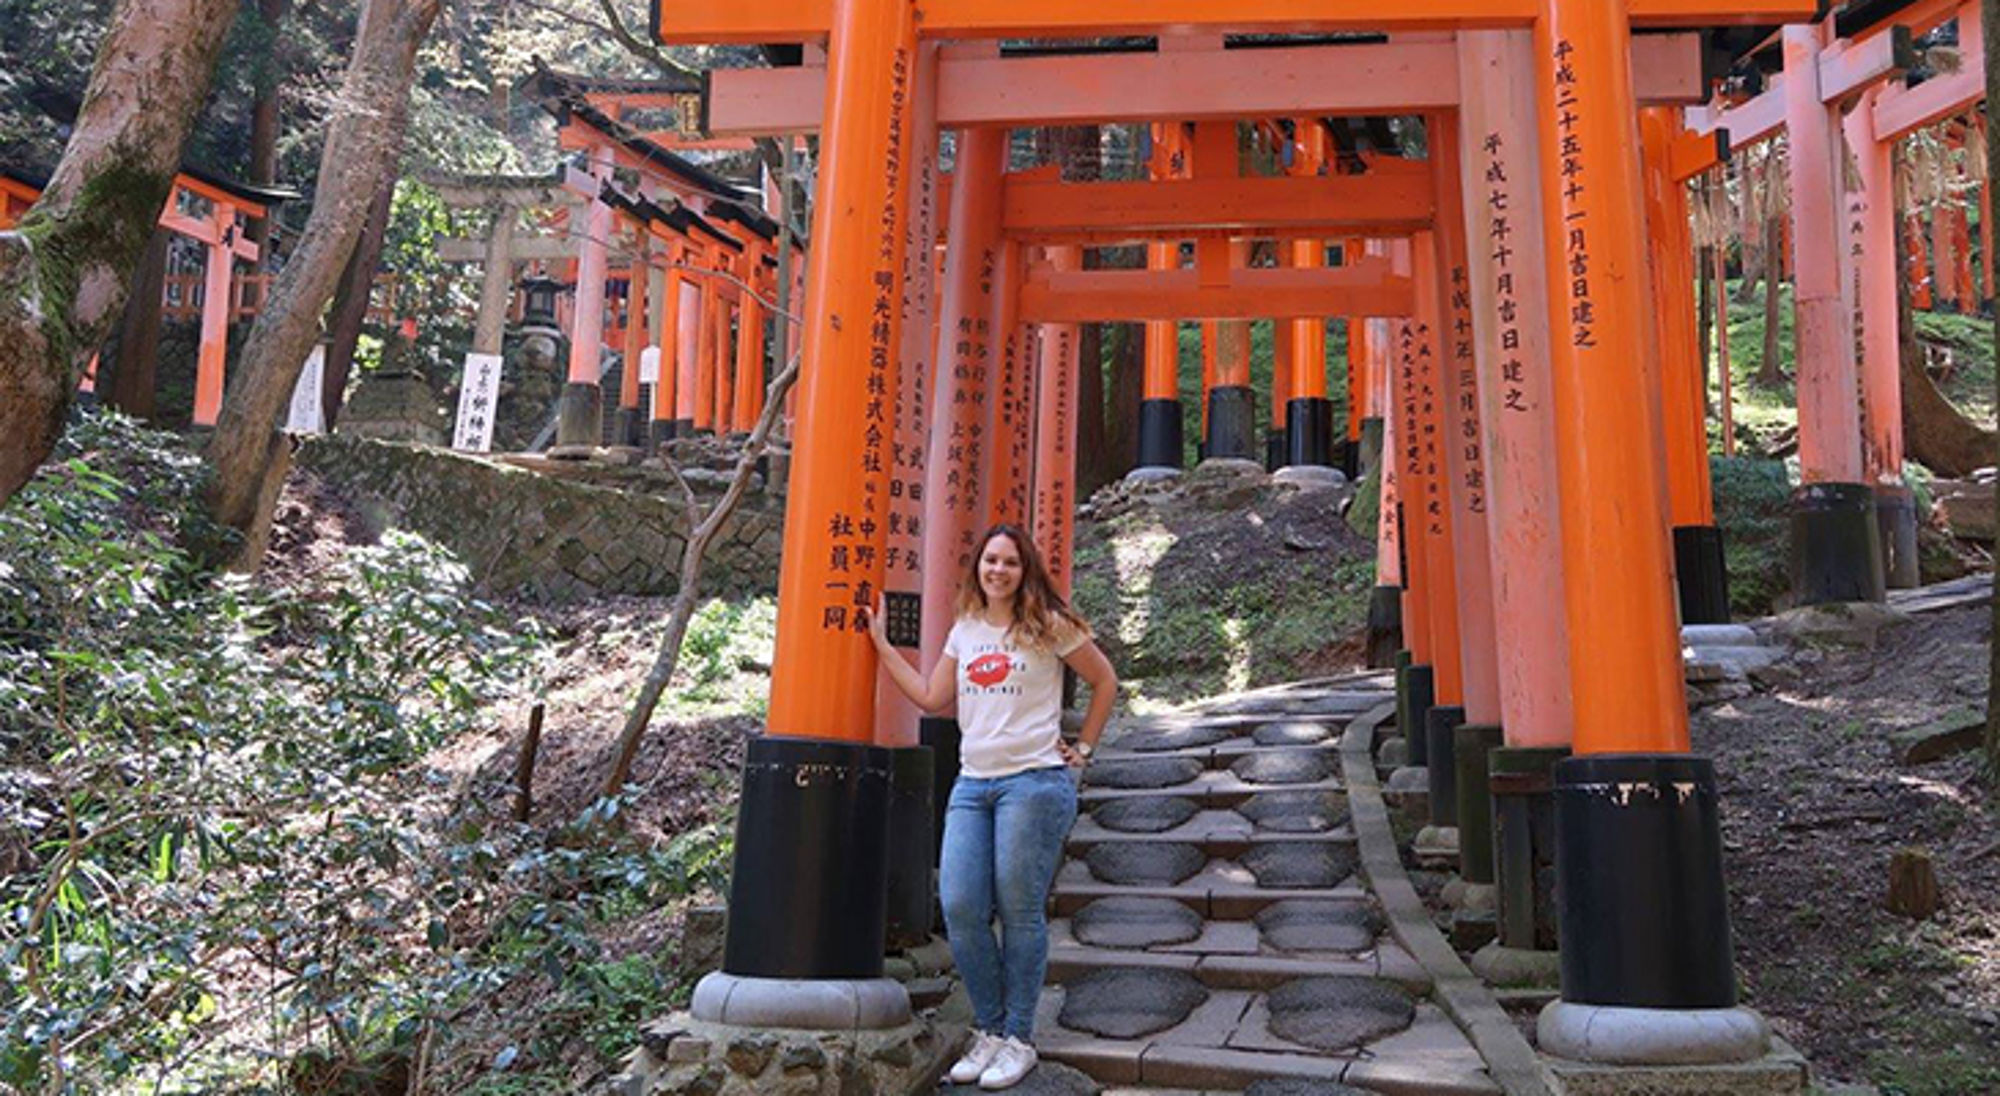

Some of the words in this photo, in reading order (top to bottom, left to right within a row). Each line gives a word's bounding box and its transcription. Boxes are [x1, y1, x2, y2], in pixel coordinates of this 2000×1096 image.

[1483, 133, 1527, 412] 平成七年十月吉日建之
[1553, 40, 1598, 349] 平成二十五年十一月吉日建之
[1400, 317, 1421, 475] 成十九年十一月吉日建之
[1450, 265, 1485, 514] 平成十年三月吉日建之
[823, 513, 854, 631] 社員一同
